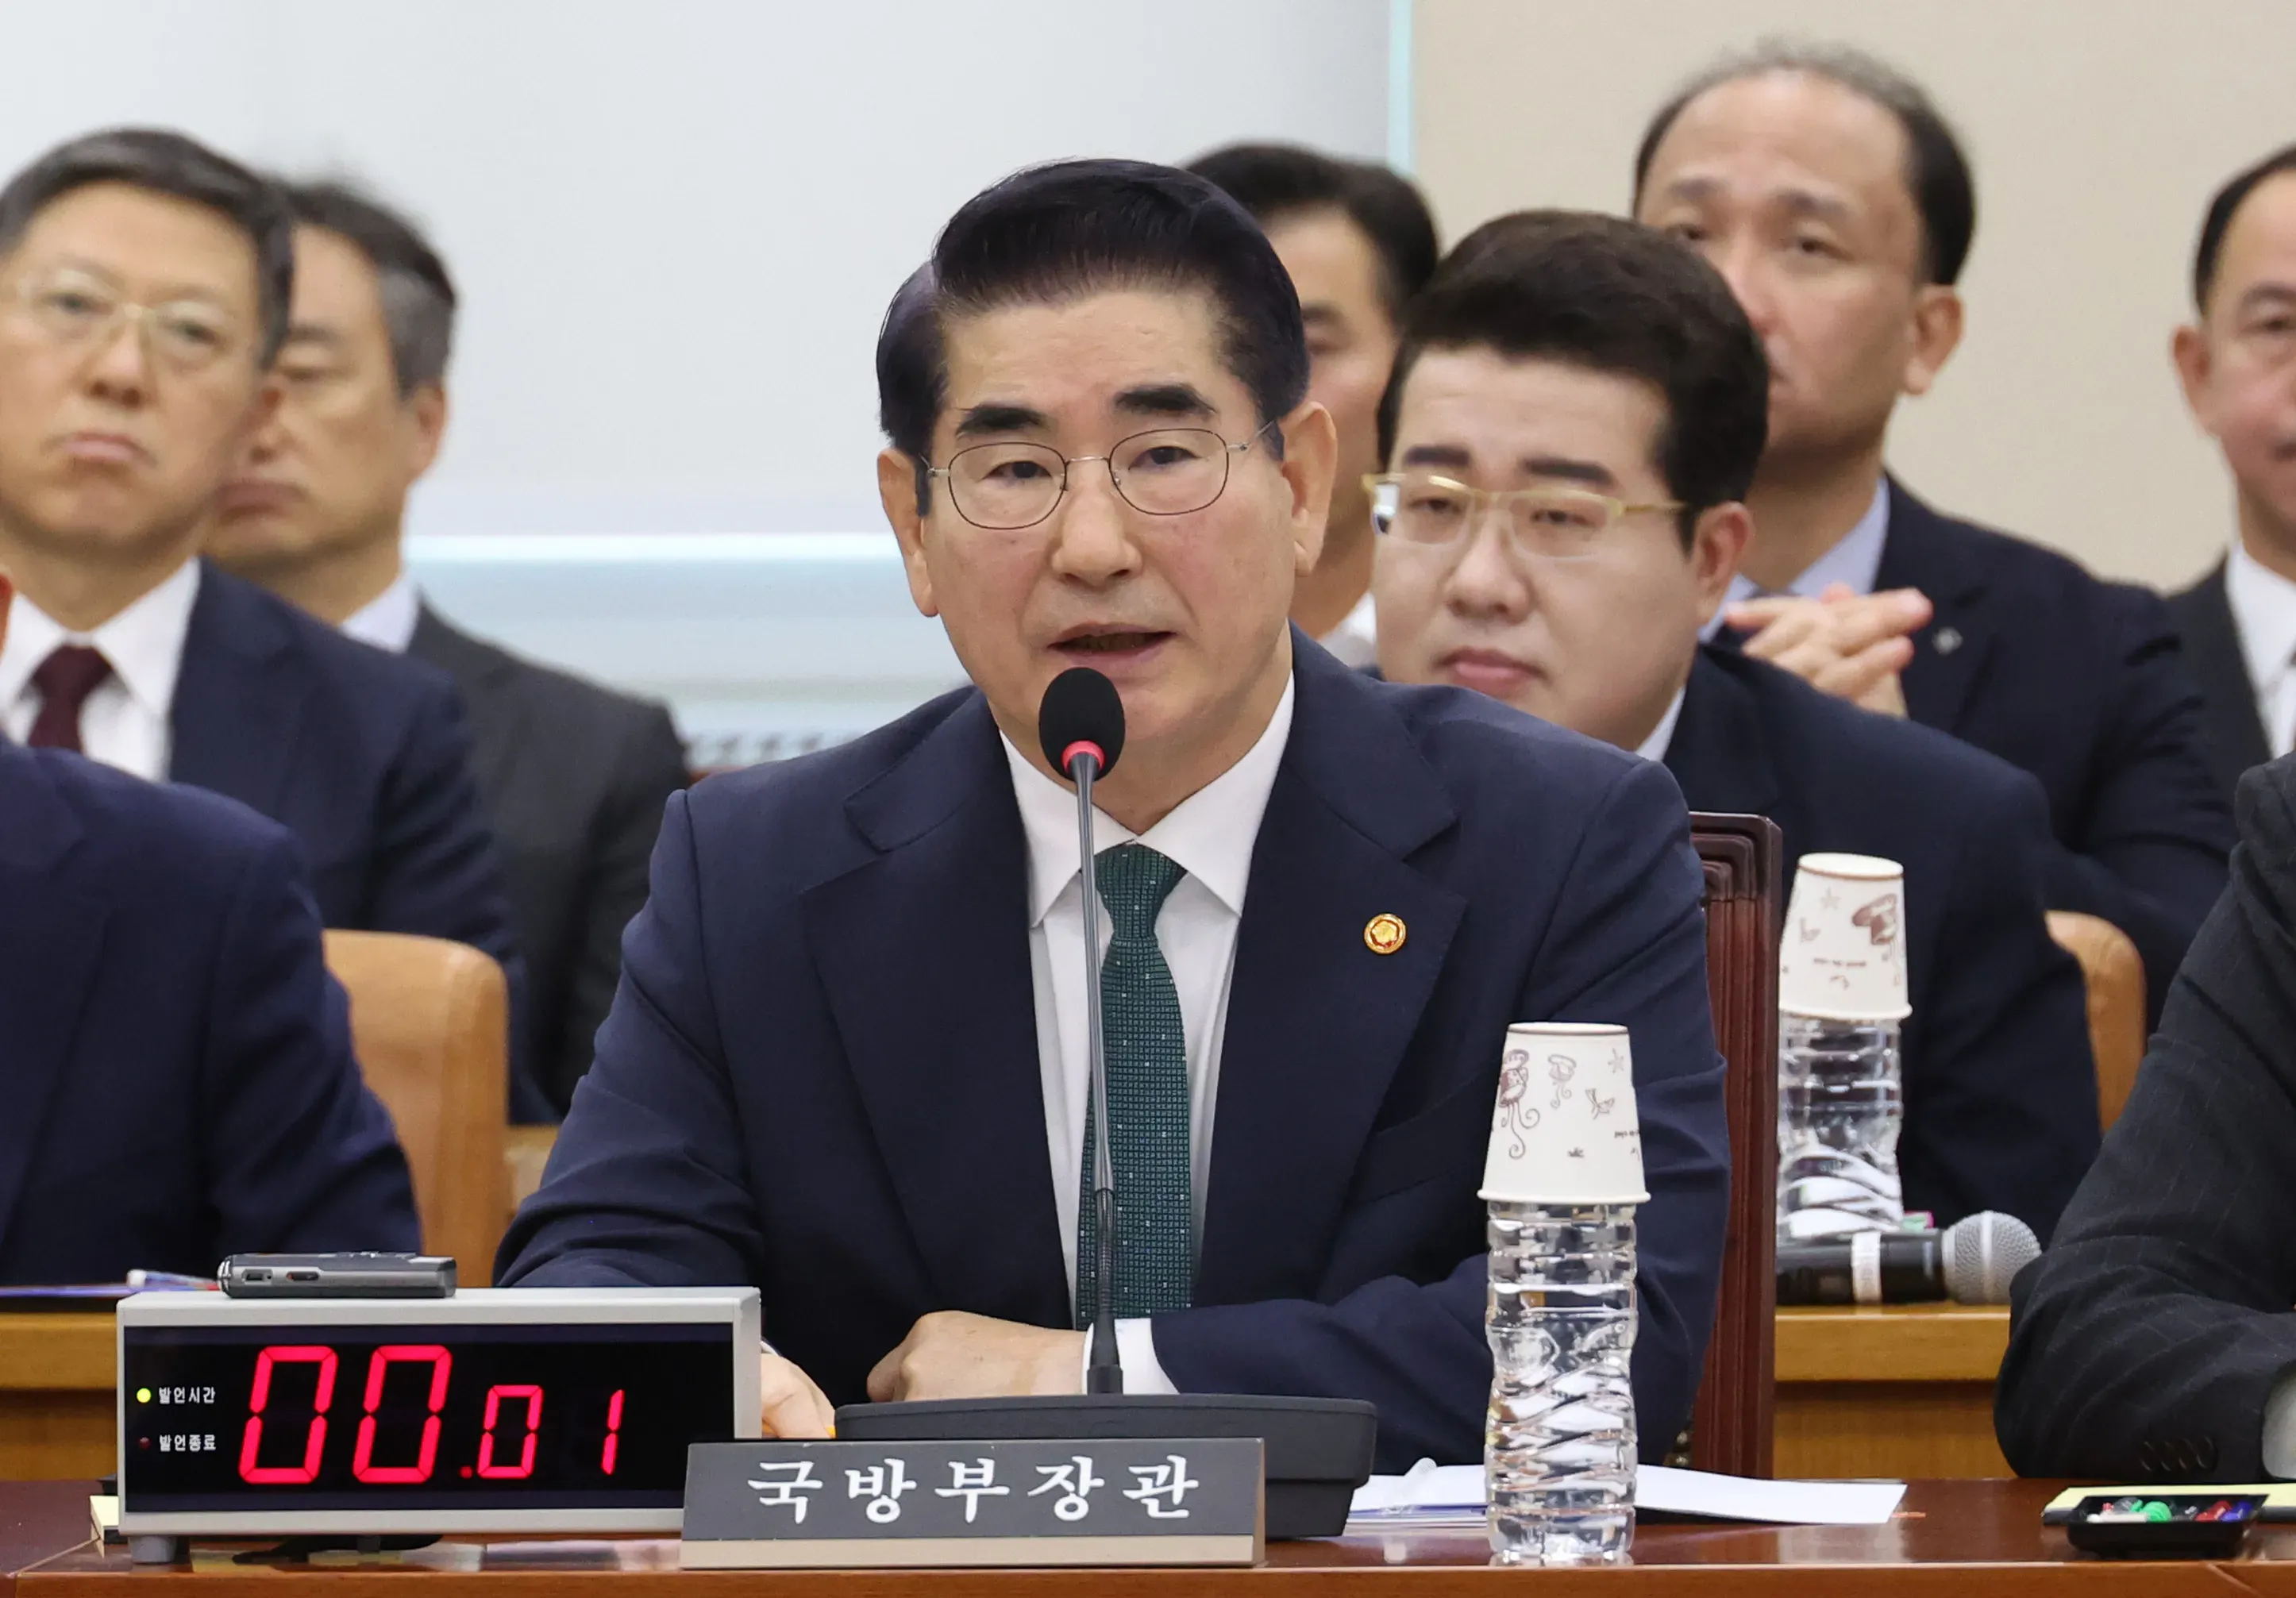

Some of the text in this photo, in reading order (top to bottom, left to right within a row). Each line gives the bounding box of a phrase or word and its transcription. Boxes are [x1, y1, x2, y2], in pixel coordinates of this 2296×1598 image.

[158, 1386, 216, 1404] 발언시간
[159, 1434, 217, 1452] 발언종료
[747, 1454, 1200, 1524] 국방부장관
